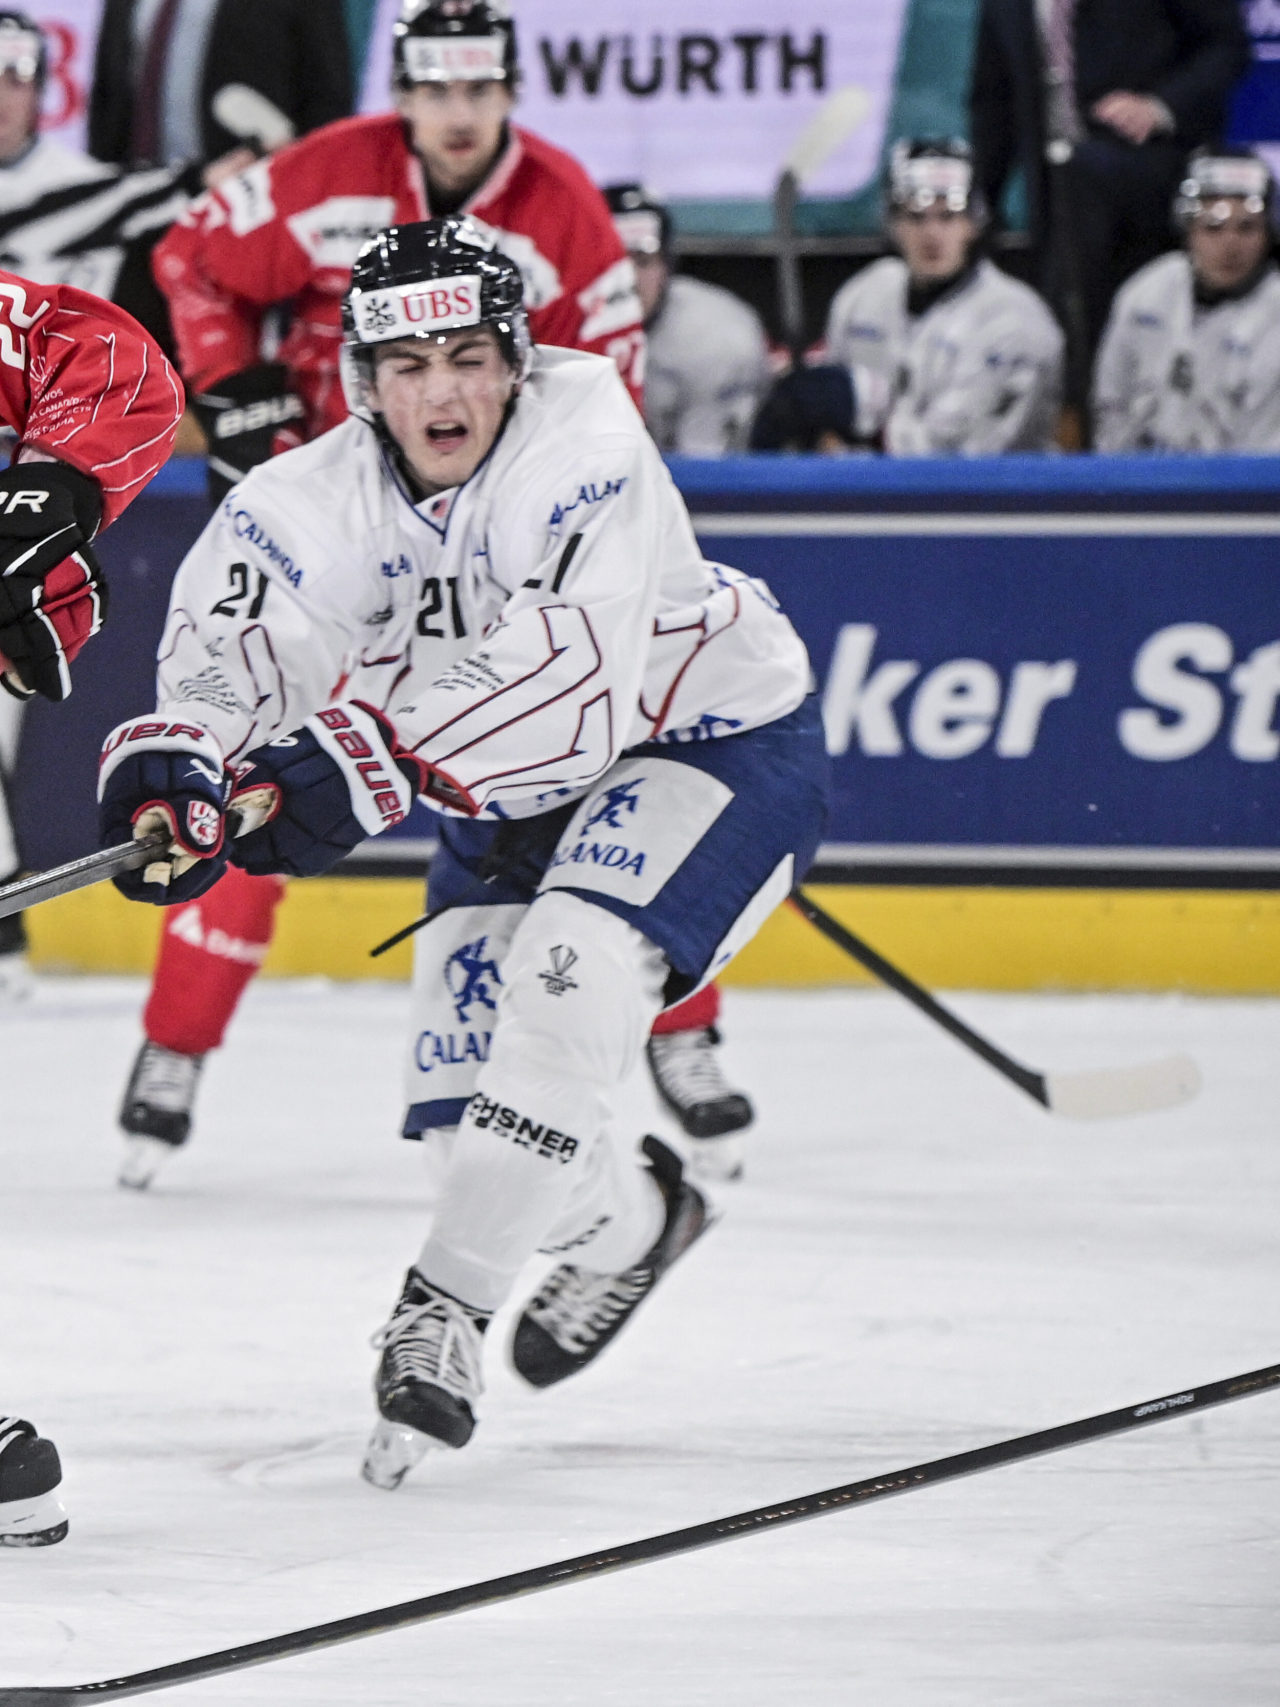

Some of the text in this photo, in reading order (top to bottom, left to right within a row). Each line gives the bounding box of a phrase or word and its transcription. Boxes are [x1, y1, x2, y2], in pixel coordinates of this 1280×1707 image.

[400, 286, 473, 323] UBS
[209, 562, 269, 619] 21
[417, 576, 468, 639] 21
[822, 622, 1079, 760] ker
